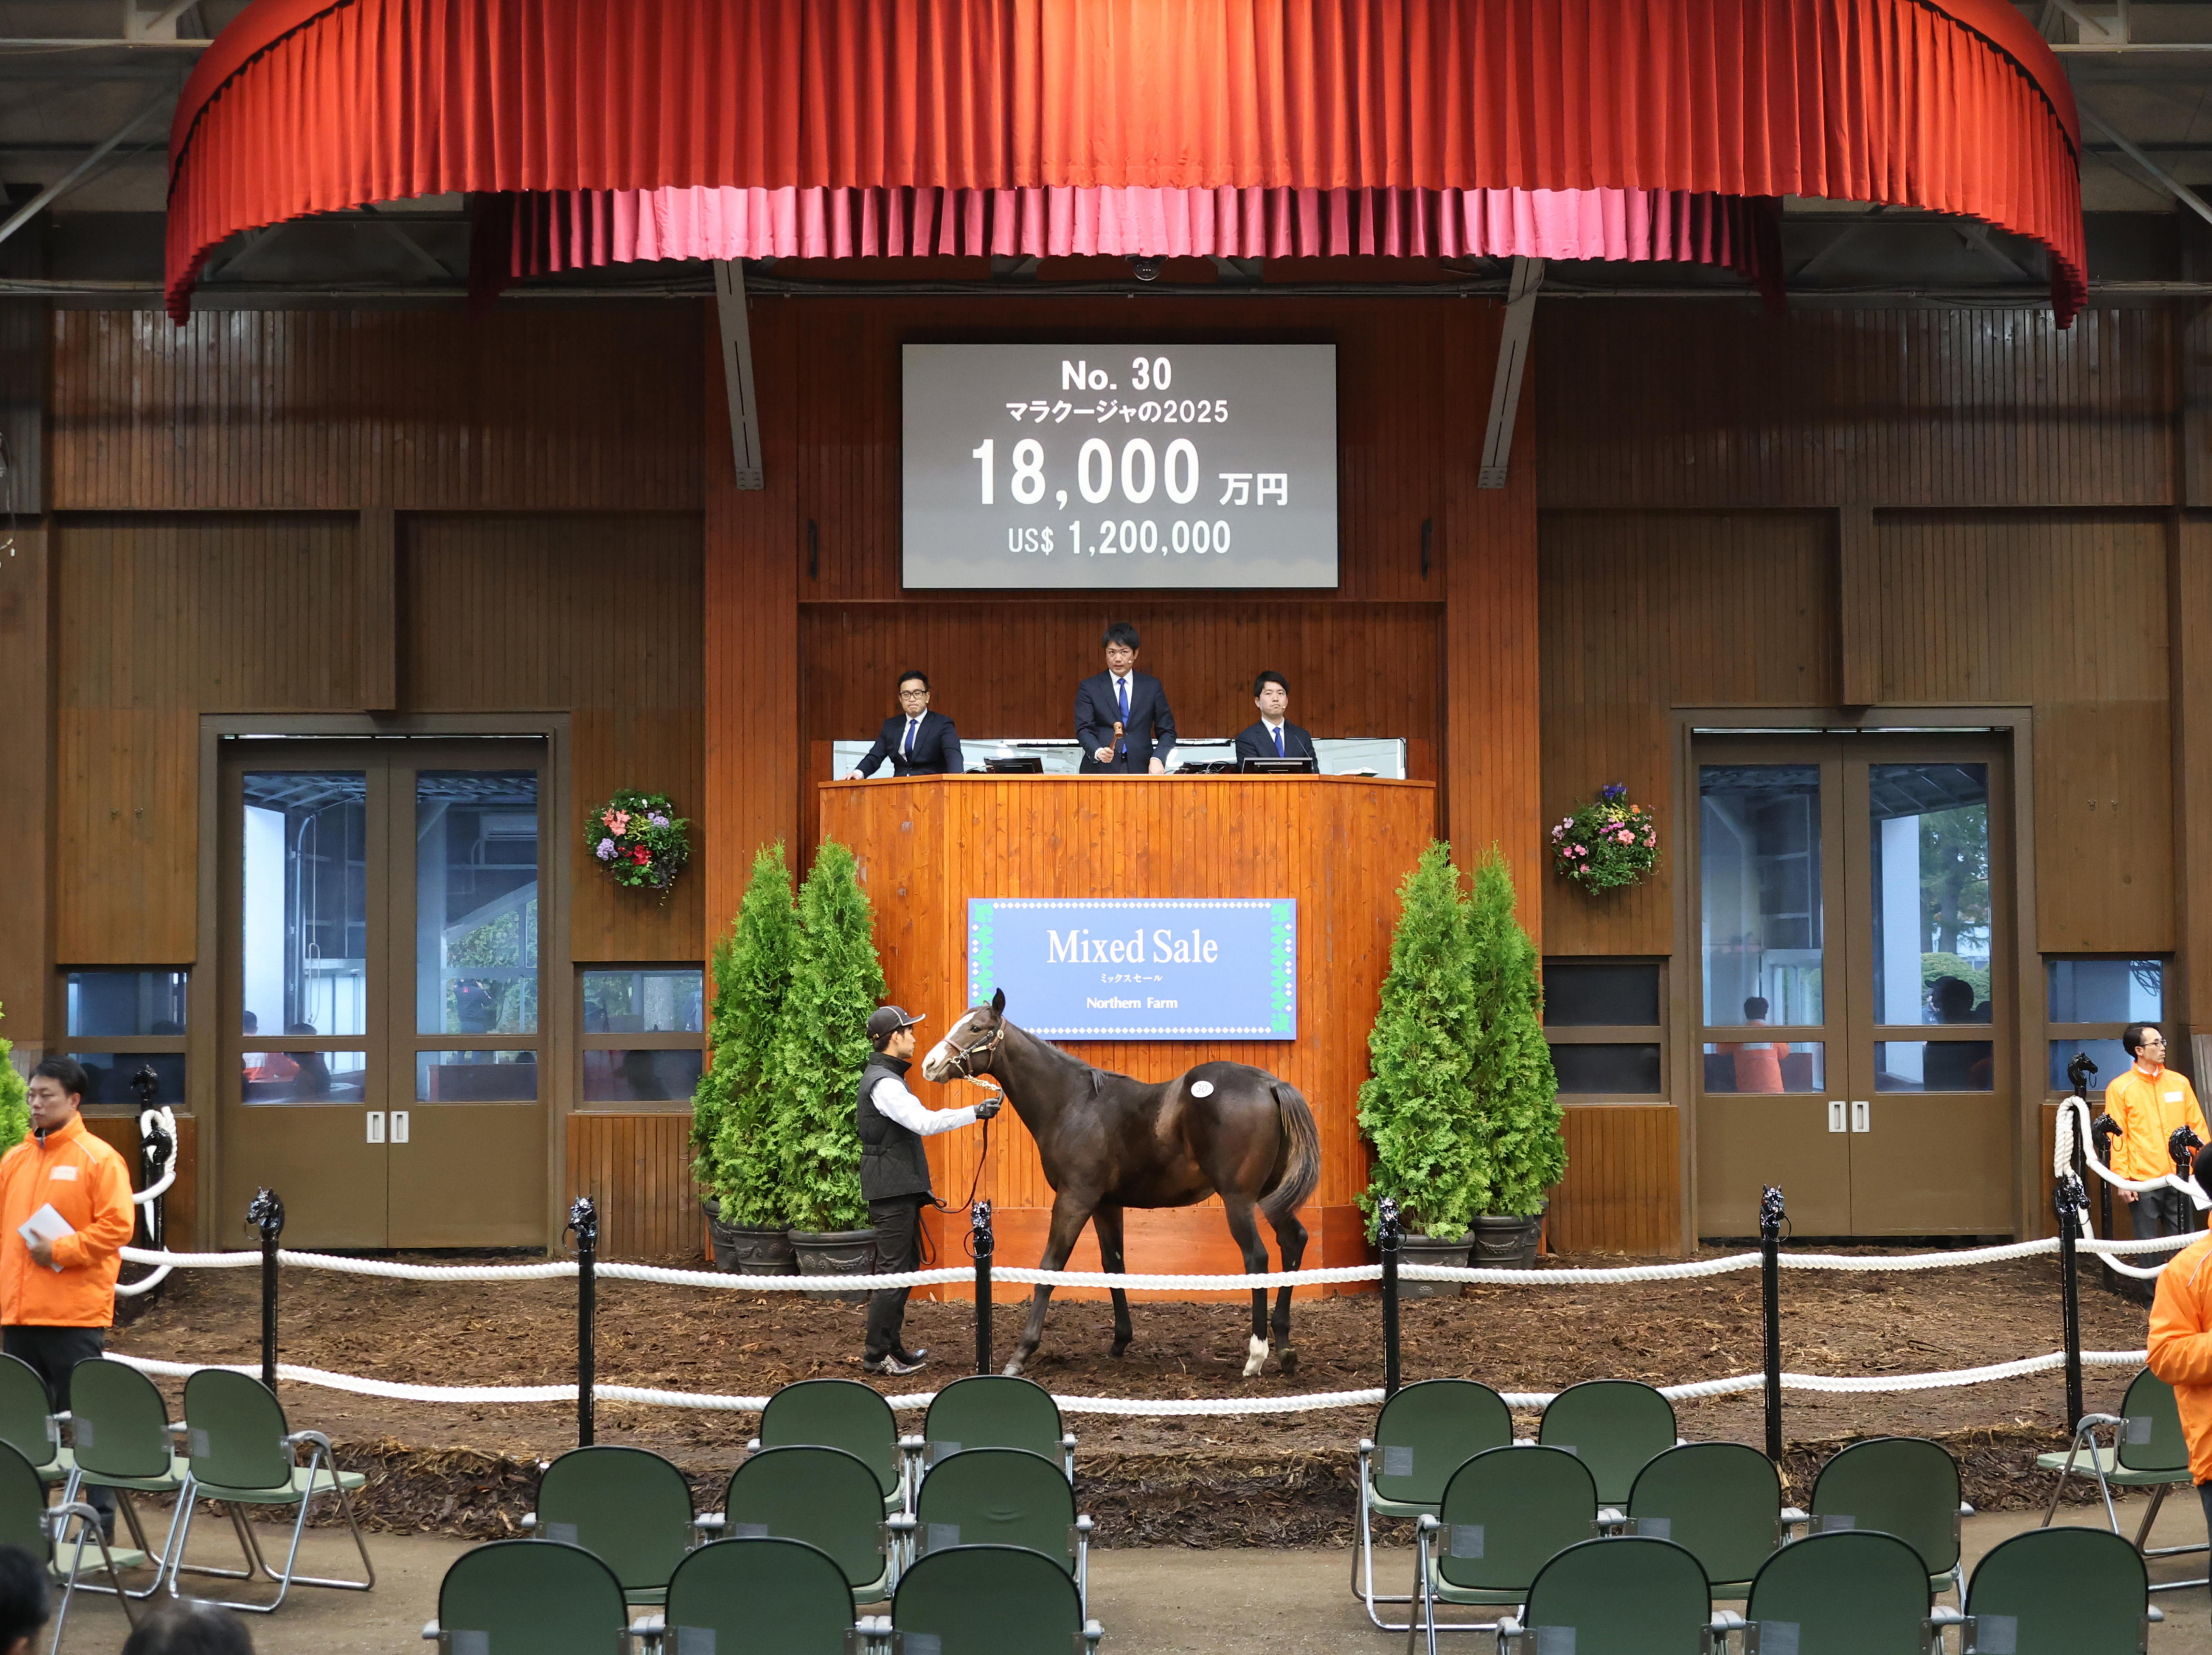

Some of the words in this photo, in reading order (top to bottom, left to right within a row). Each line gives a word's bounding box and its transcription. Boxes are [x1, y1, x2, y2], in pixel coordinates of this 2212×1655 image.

[1062, 361, 1117, 390] No.
[1132, 357, 1172, 390] 30
[1006, 400, 1228, 423] マラクージャの2025
[973, 438, 1199, 510] 18,000
[1218, 473, 1288, 506] 万円
[1009, 527, 1054, 556] US$
[1068, 519, 1231, 557] 1,200,000
[1046, 929, 1146, 963] Mixed
[1152, 929, 1218, 963] Sale
[1100, 973, 1164, 984] ミックスセール
[1086, 996, 1141, 1009] Northern
[1147, 996, 1178, 1009] Farm
[1196, 1084, 1208, 1093] 30
